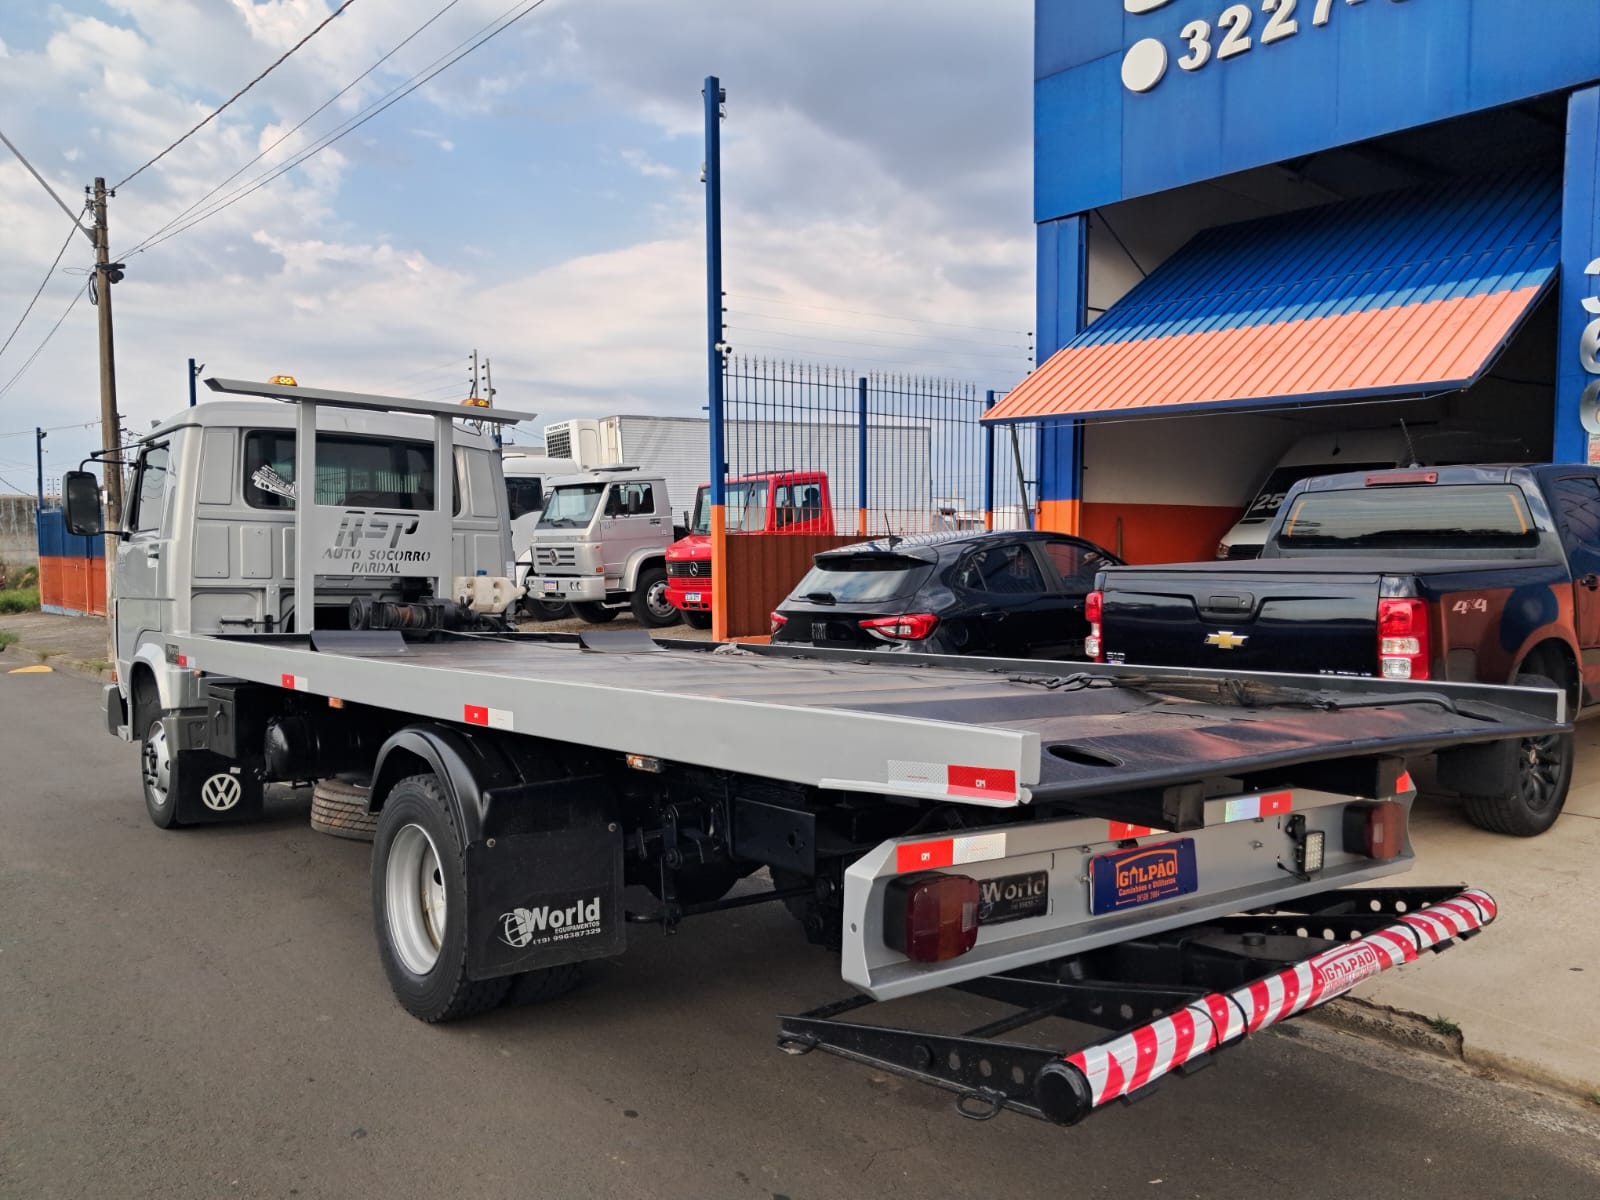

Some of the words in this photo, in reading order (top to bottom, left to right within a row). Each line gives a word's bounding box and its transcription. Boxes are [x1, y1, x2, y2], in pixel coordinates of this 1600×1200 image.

[322, 547, 362, 560] AUTO
[368, 549, 431, 562] SOCORRO
[351, 561, 401, 574] PARDAL
[981, 875, 1047, 904] World
[526, 896, 600, 933] World
[554, 920, 601, 934] EQUIPAMENTOS
